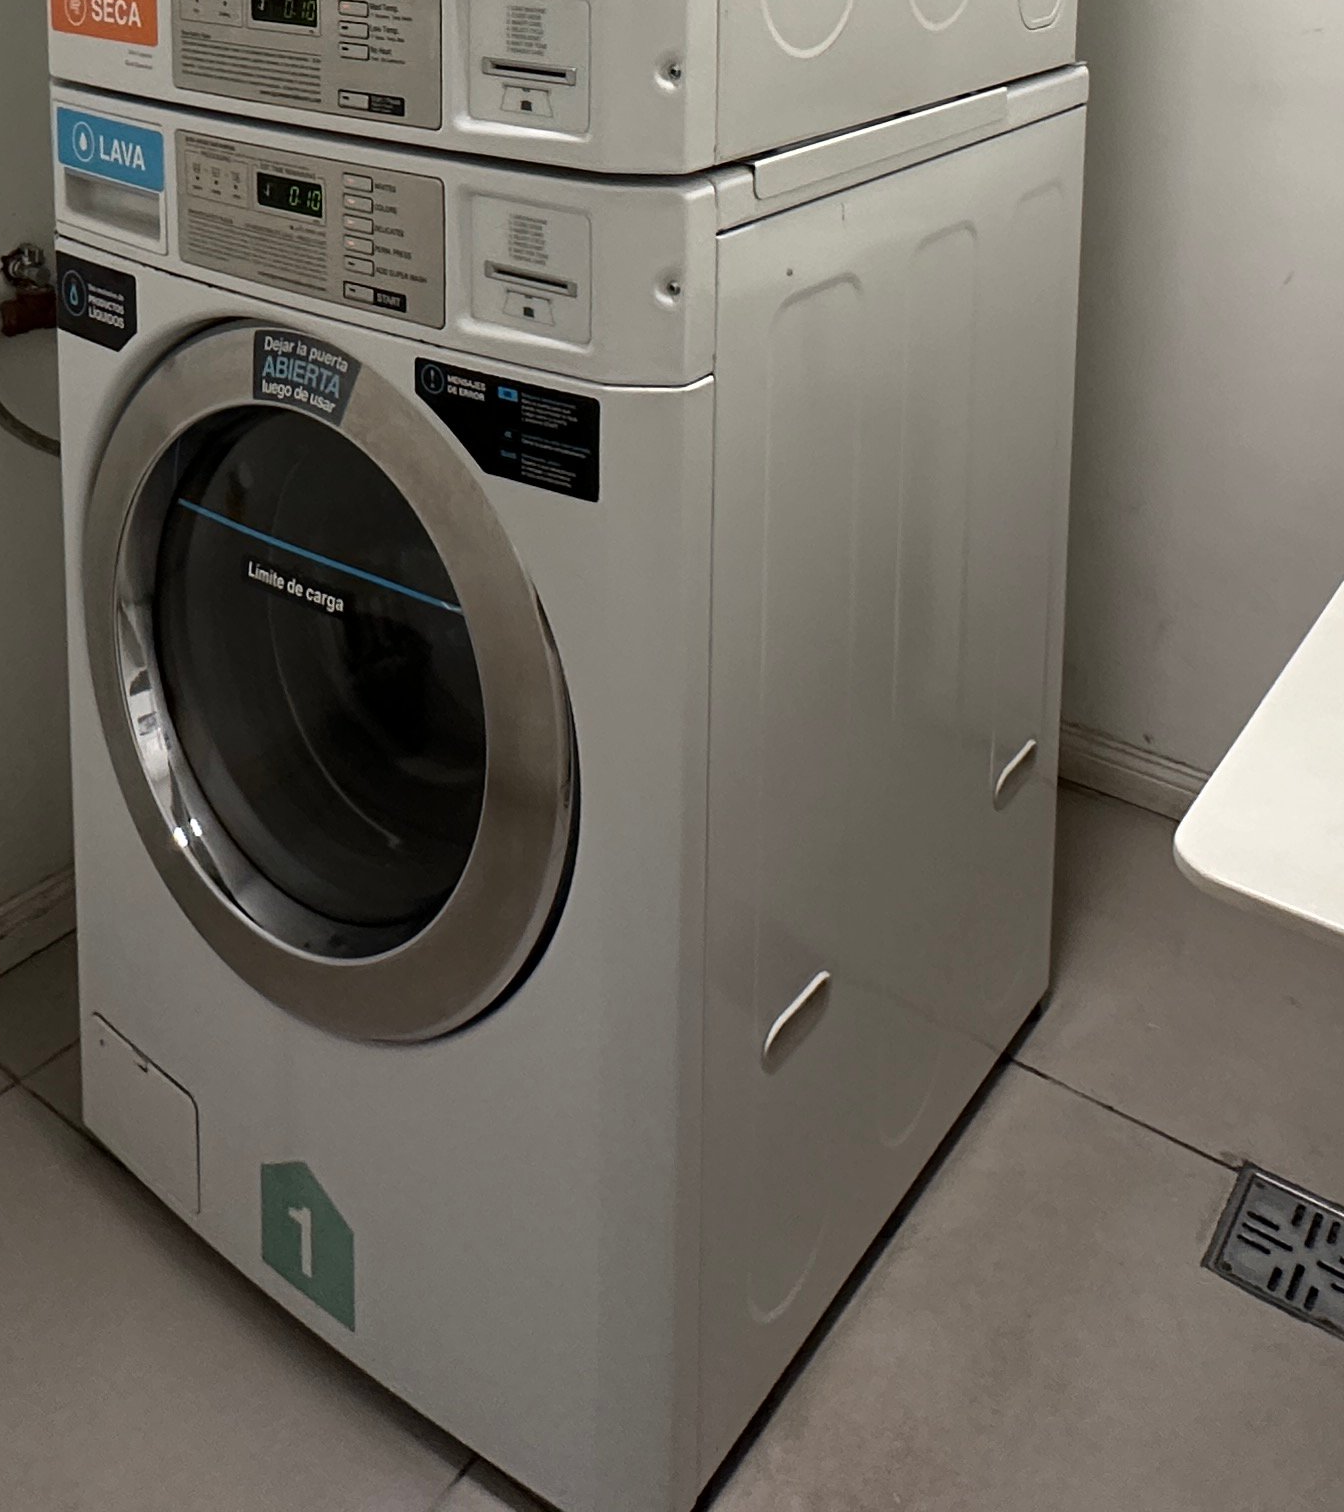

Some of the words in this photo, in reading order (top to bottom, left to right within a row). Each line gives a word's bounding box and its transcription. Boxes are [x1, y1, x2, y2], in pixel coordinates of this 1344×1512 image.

[99, 134, 146, 171] LAVA
[264, 336, 295, 355] Dejar
[297, 340, 307, 356] la
[309, 348, 349, 372] puerta
[262, 355, 340, 398] ABIERTA
[262, 379, 292, 399] luego
[294, 386, 309, 401] de
[310, 394, 336, 413] usar
[287, 578, 303, 597] de
[306, 588, 344, 612] carga
[288, 1206, 313, 1279] 1
